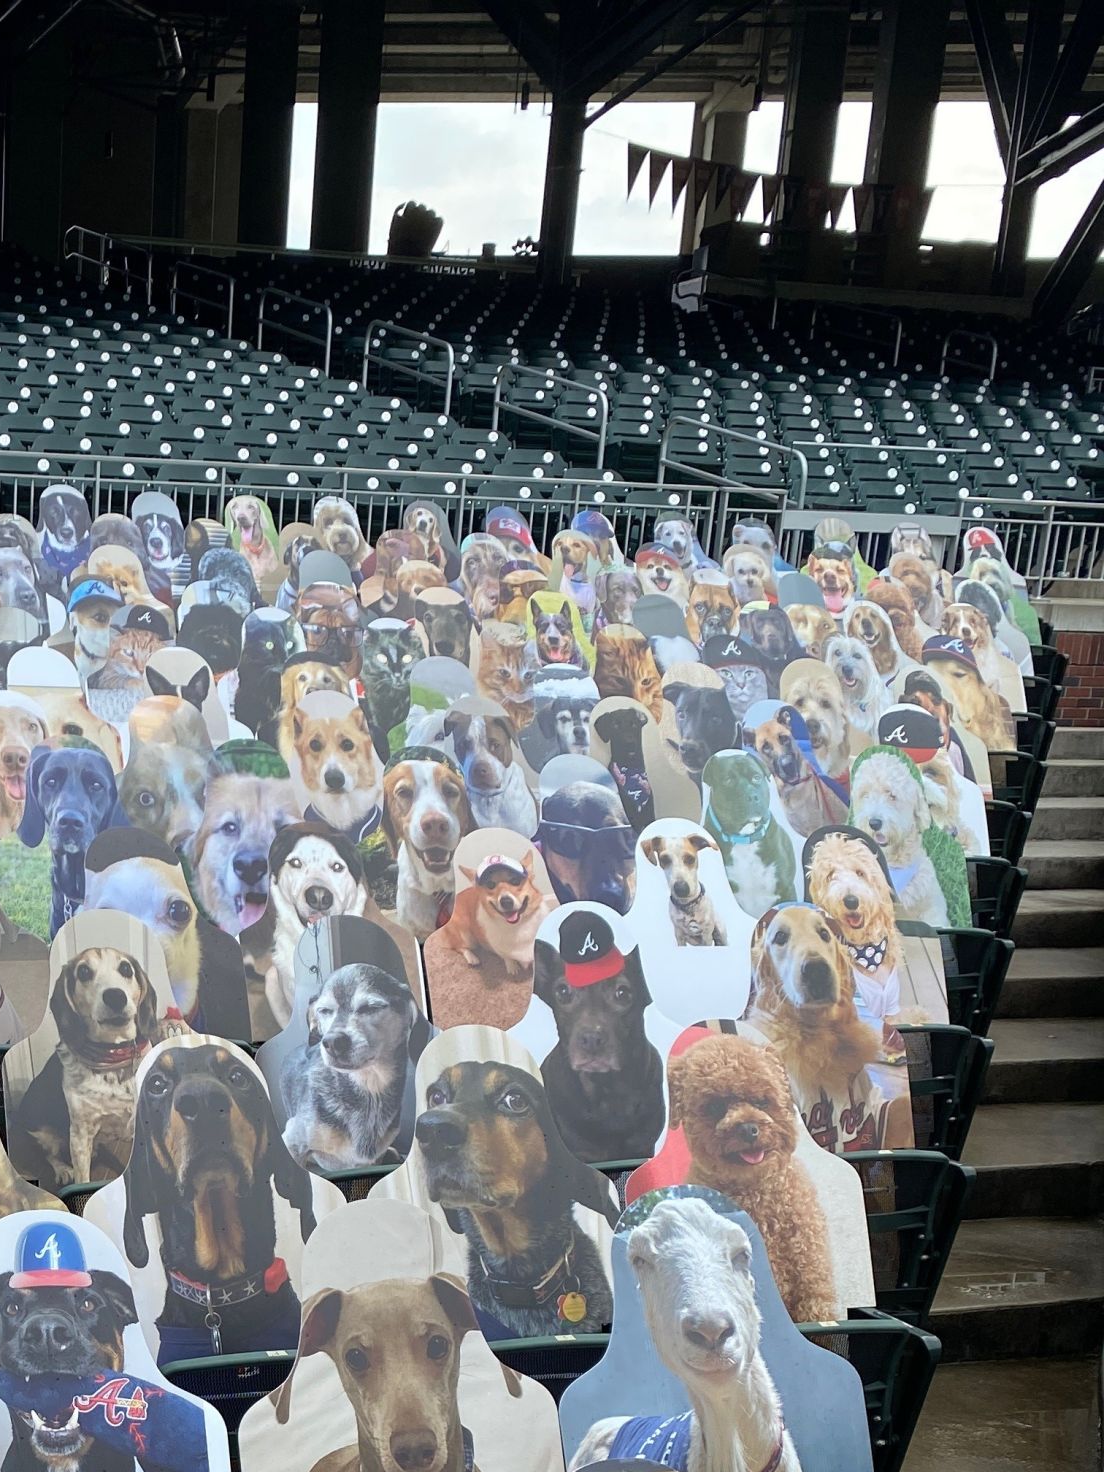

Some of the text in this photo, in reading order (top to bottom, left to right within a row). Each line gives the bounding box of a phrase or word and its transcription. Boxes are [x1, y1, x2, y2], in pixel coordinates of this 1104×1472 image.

[138, 612, 152, 623] A
[722, 641, 742, 656] A
[885, 725, 908, 743] A
[578, 932, 599, 956] A
[35, 1233, 61, 1260] A
